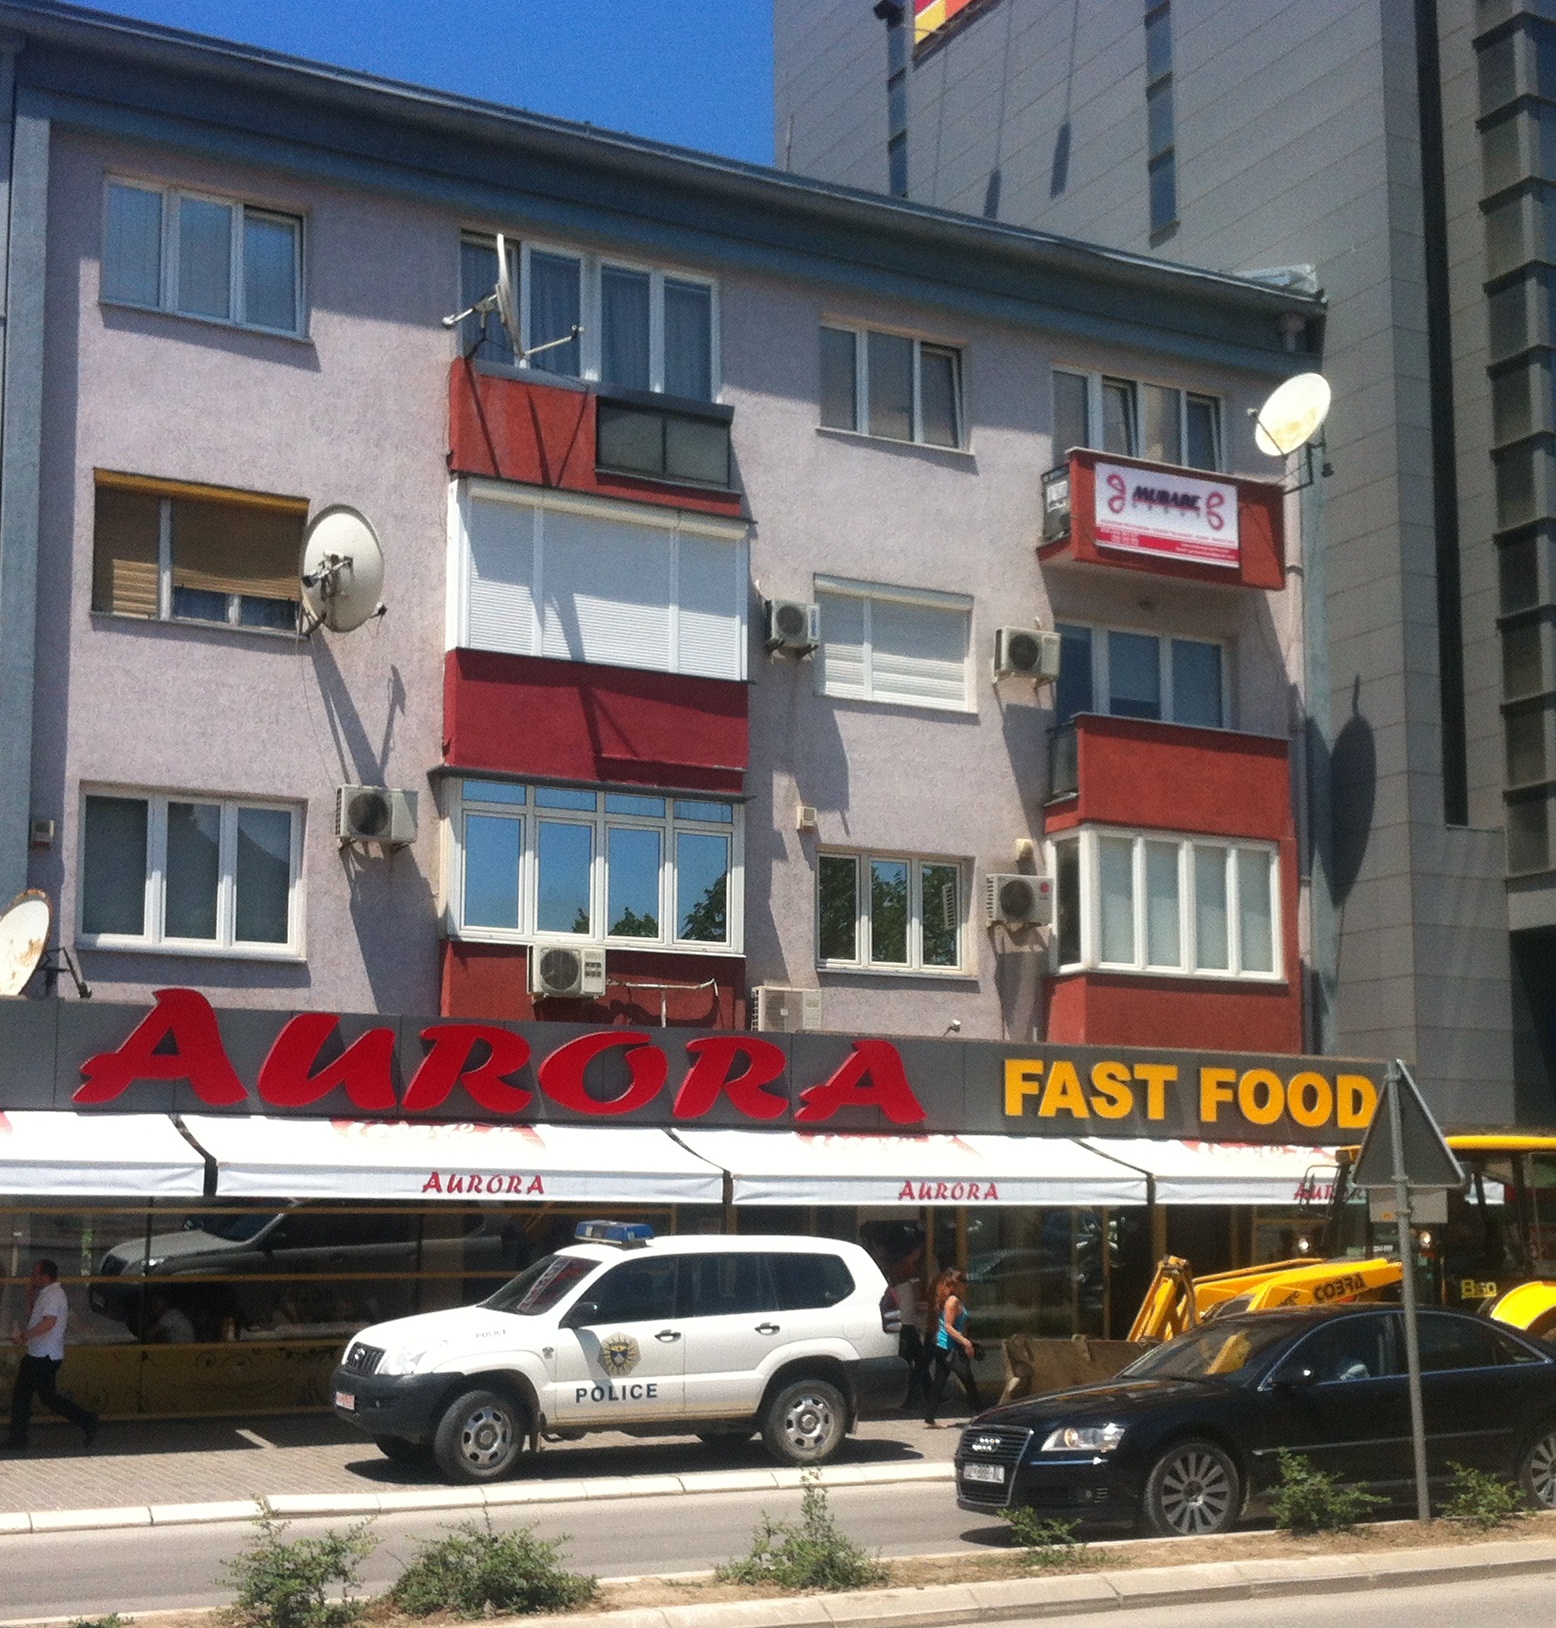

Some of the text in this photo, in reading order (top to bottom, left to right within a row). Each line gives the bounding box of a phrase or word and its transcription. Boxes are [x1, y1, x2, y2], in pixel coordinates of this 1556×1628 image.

[72, 987, 927, 1125] AURORA
[1004, 1058, 1379, 1129] FAST FOOD
[422, 1171, 545, 1195] AURORA
[898, 1180, 1000, 1201] AURORA
[575, 1383, 658, 1405] POLICE
